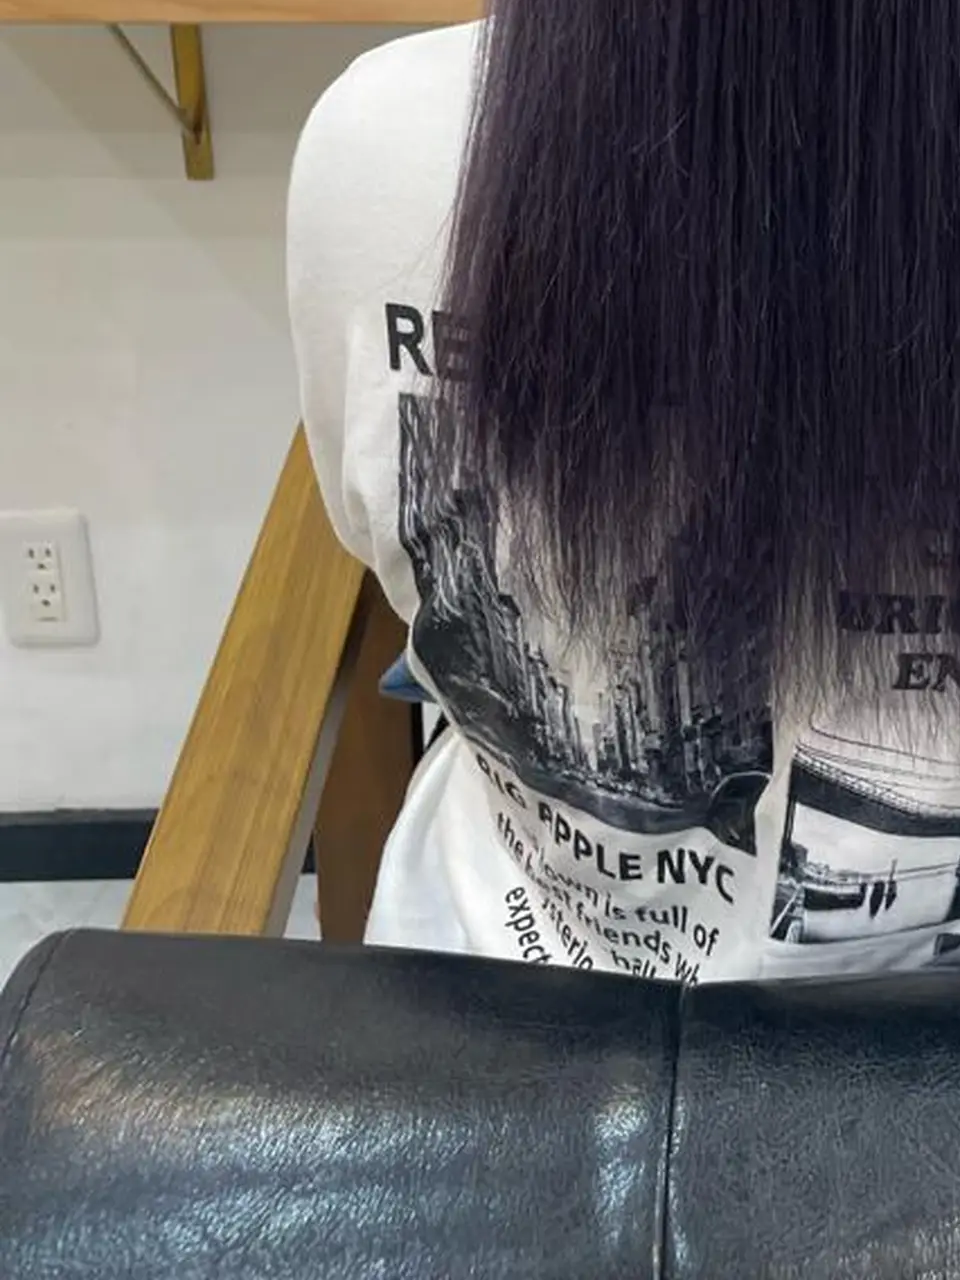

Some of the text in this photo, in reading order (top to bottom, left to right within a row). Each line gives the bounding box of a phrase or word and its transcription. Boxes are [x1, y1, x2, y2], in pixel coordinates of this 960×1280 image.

[497, 812, 524, 862] the
[604, 891, 627, 921] is
[634, 904, 688, 934] full
[693, 923, 720, 957] of
[538, 801, 643, 881] APPLE
[657, 847, 734, 904] NYC
